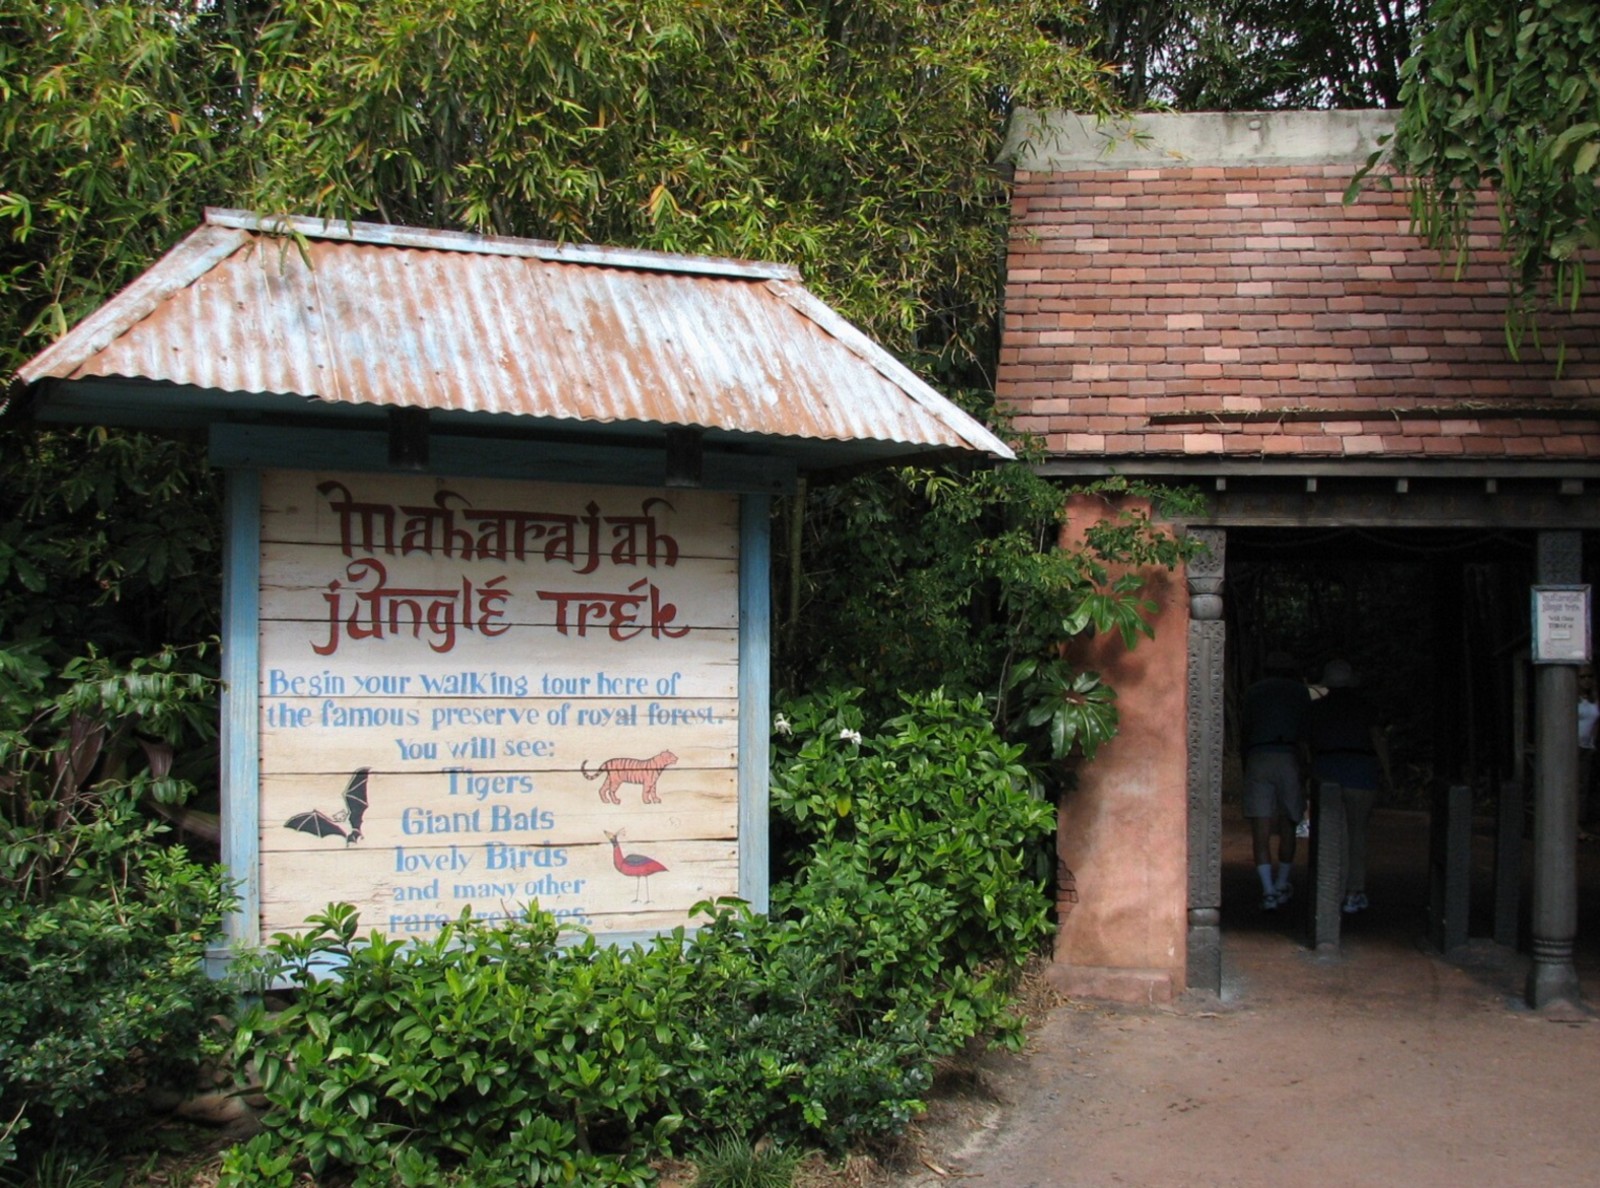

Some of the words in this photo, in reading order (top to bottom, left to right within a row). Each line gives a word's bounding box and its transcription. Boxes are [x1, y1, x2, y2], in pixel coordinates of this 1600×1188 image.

[269, 669, 345, 698] Begin
[353, 674, 411, 696] your
[419, 670, 529, 698] walking
[542, 673, 592, 696] tour
[597, 671, 648, 696] here
[656, 671, 681, 696] of
[267, 703, 312, 727] the
[321, 701, 420, 727] famous
[431, 706, 540, 731] preserve
[545, 704, 568, 727] of
[577, 704, 636, 729] royal
[647, 702, 724, 727] forest.
[395, 738, 436, 761] You
[446, 737, 495, 760] will
[503, 739, 556, 759] see:
[442, 767, 533, 801] Tigers
[401, 807, 482, 835] Giant
[490, 804, 555, 832] Bats
[394, 844, 473, 874] lovely
[484, 840, 568, 870] Birds
[393, 879, 439, 902] and
[453, 882, 518, 903] many
[525, 873, 586, 897] other
[389, 912, 450, 935] rare
